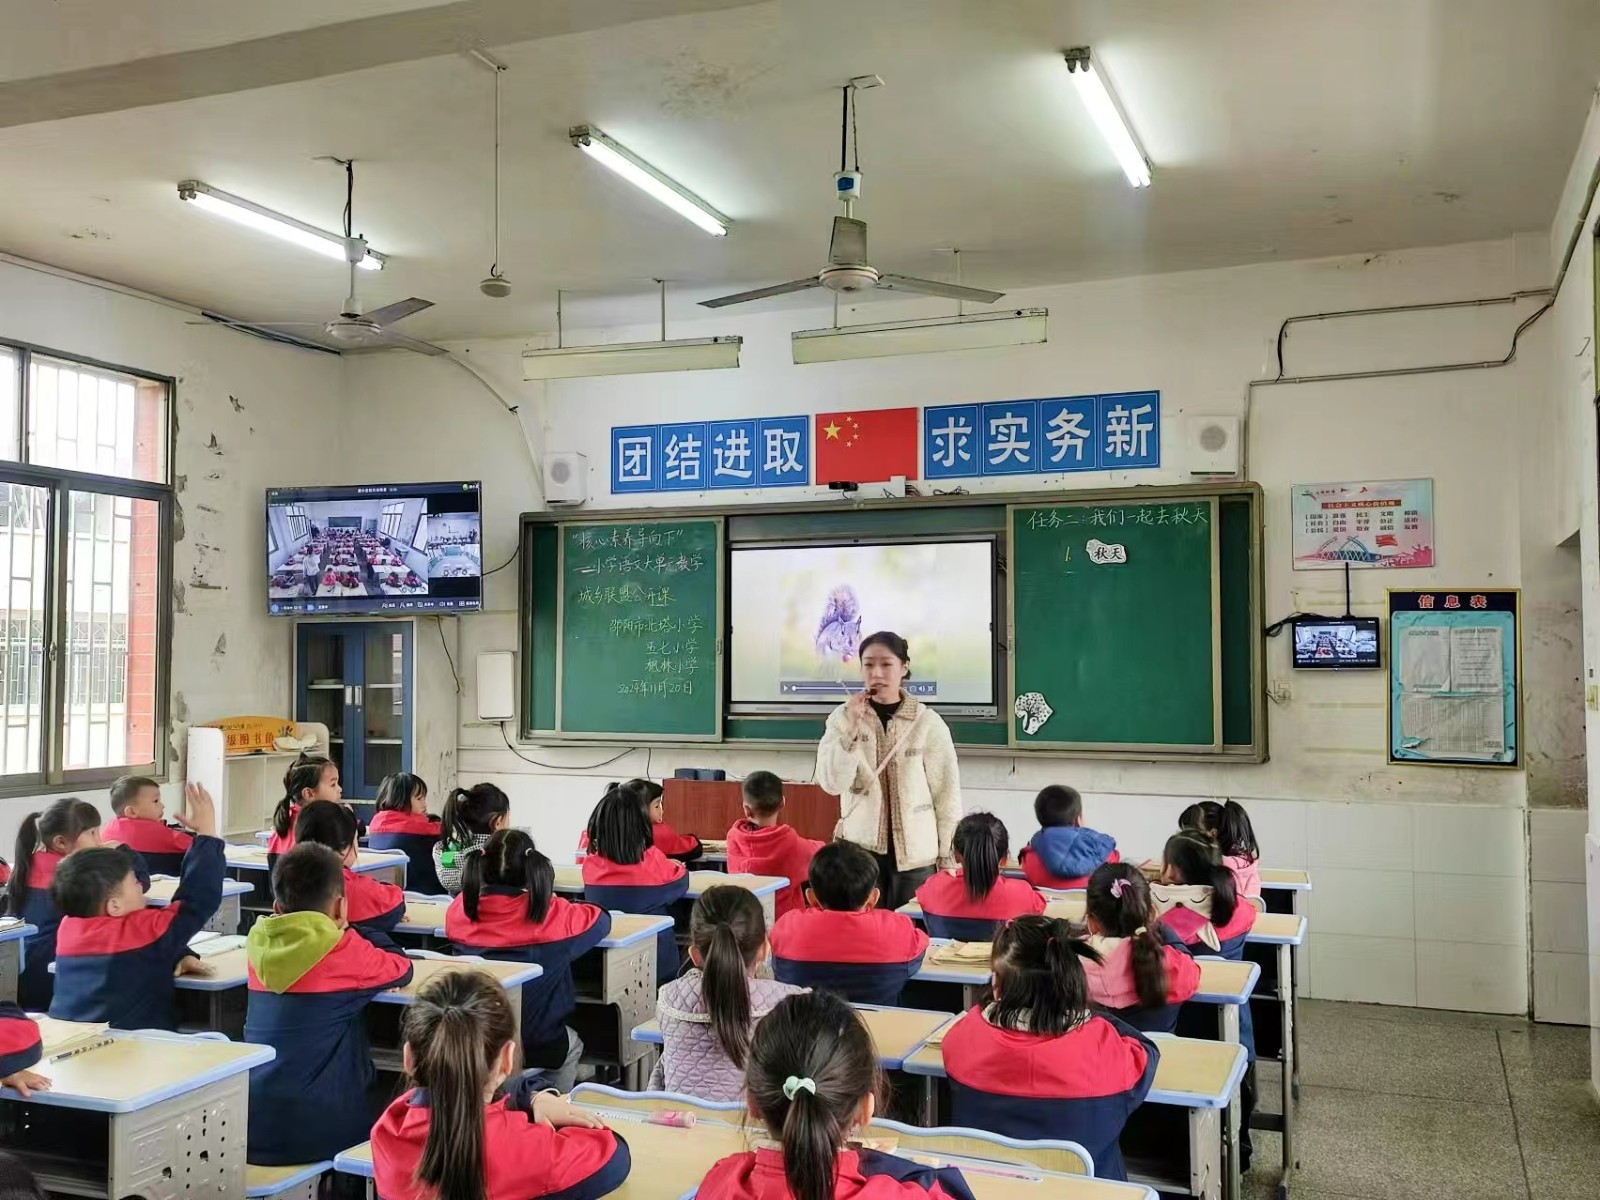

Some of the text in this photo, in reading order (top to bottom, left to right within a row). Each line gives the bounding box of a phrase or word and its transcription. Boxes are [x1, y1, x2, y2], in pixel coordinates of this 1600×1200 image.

[618, 403, 1153, 482] 团结进取 求实务新
[1094, 546, 1124, 560] 秋天
[1418, 595, 1487, 609] 信息表
